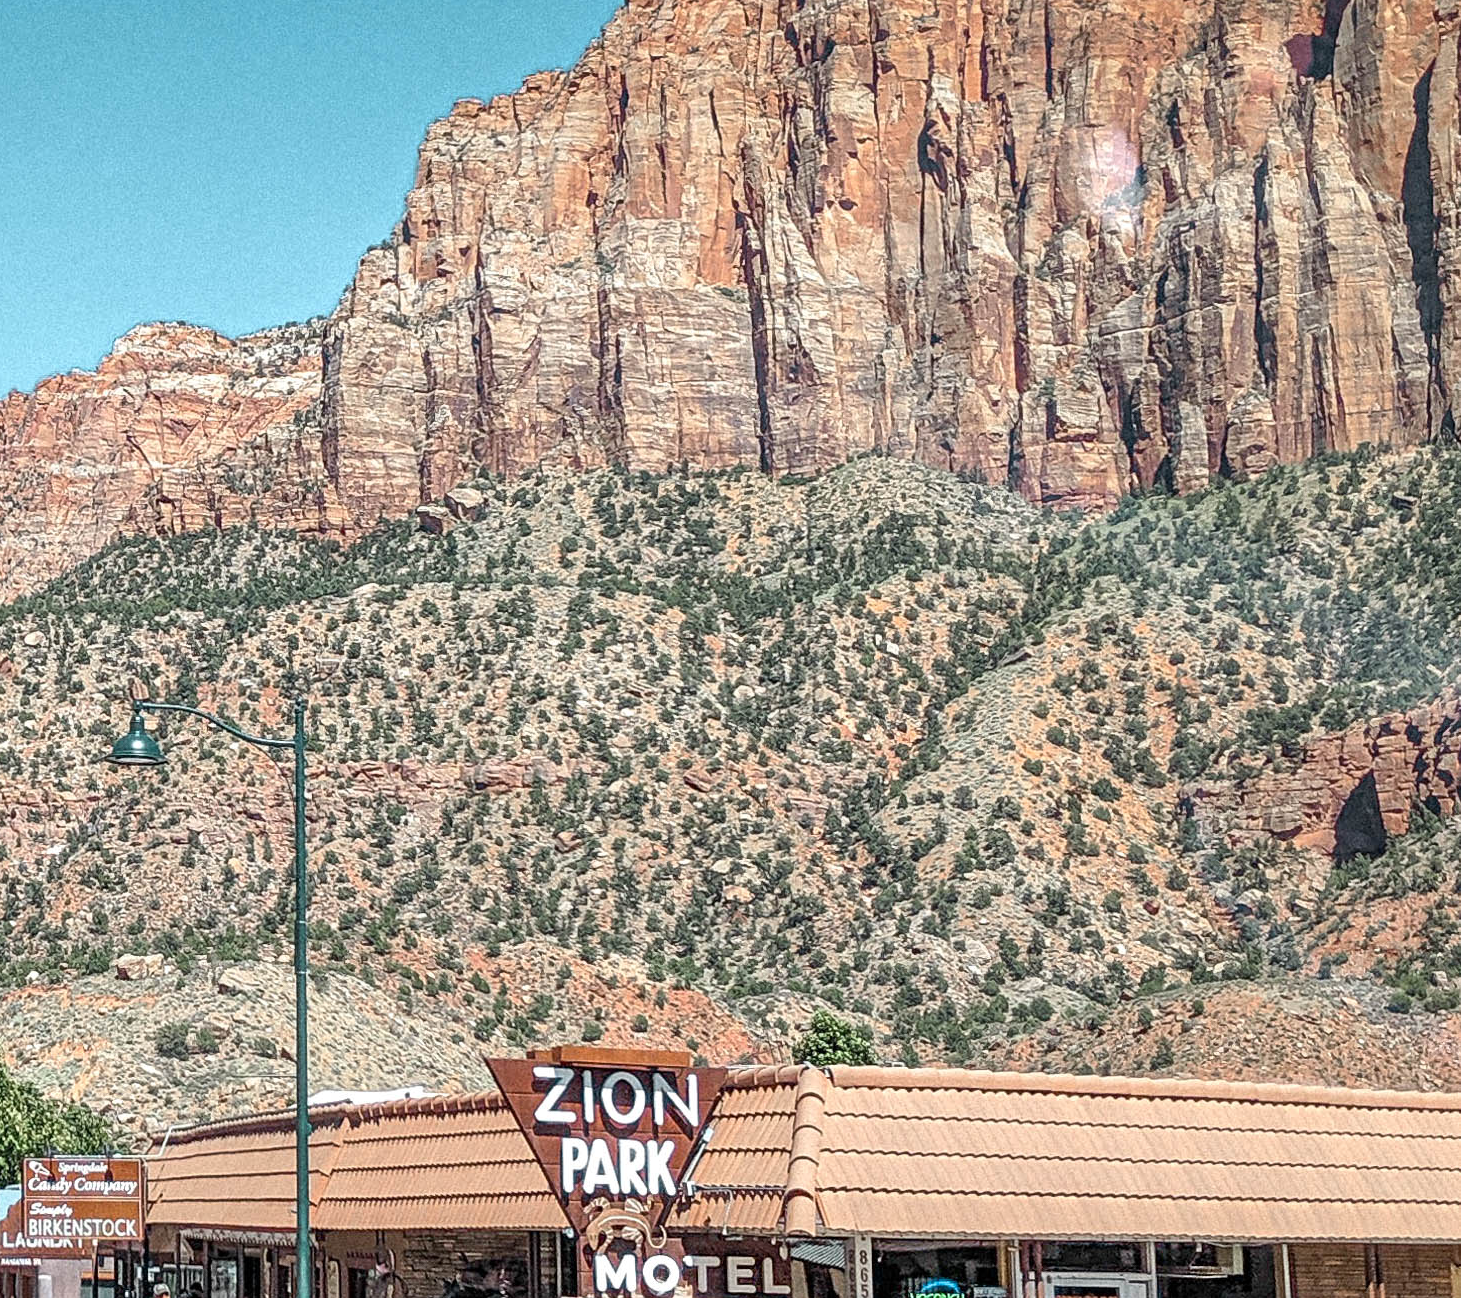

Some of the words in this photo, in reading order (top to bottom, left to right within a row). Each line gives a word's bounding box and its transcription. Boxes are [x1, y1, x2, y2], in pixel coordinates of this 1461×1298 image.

[532, 1066, 700, 1128] ZION
[27, 1176, 73, 1195] Candy
[73, 1177, 138, 1195] Company
[57, 1161, 109, 1175] Springdale
[561, 1137, 678, 1196] PARK
[28, 1218, 138, 1237] BIRKENSTOCK
[594, 1253, 791, 1296] MOTEL
[859, 1249, 869, 1298] 865
